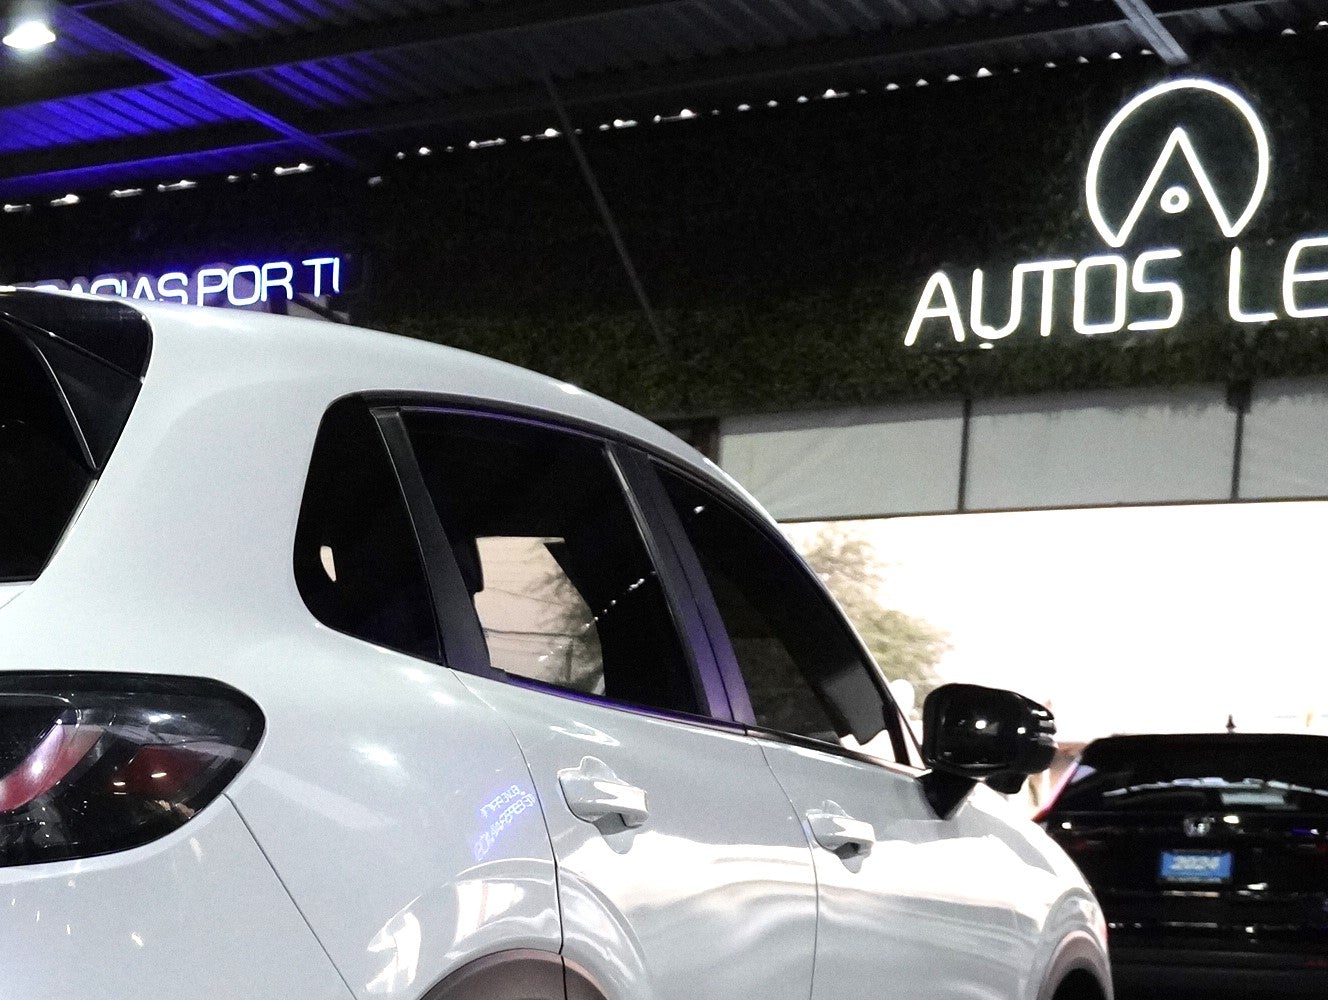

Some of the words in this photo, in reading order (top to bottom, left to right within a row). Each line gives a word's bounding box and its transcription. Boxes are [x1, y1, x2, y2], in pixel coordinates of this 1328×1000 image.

[197, 261, 294, 307] POR
[302, 257, 340, 298] TI
[903, 249, 1185, 347] AUTOS
